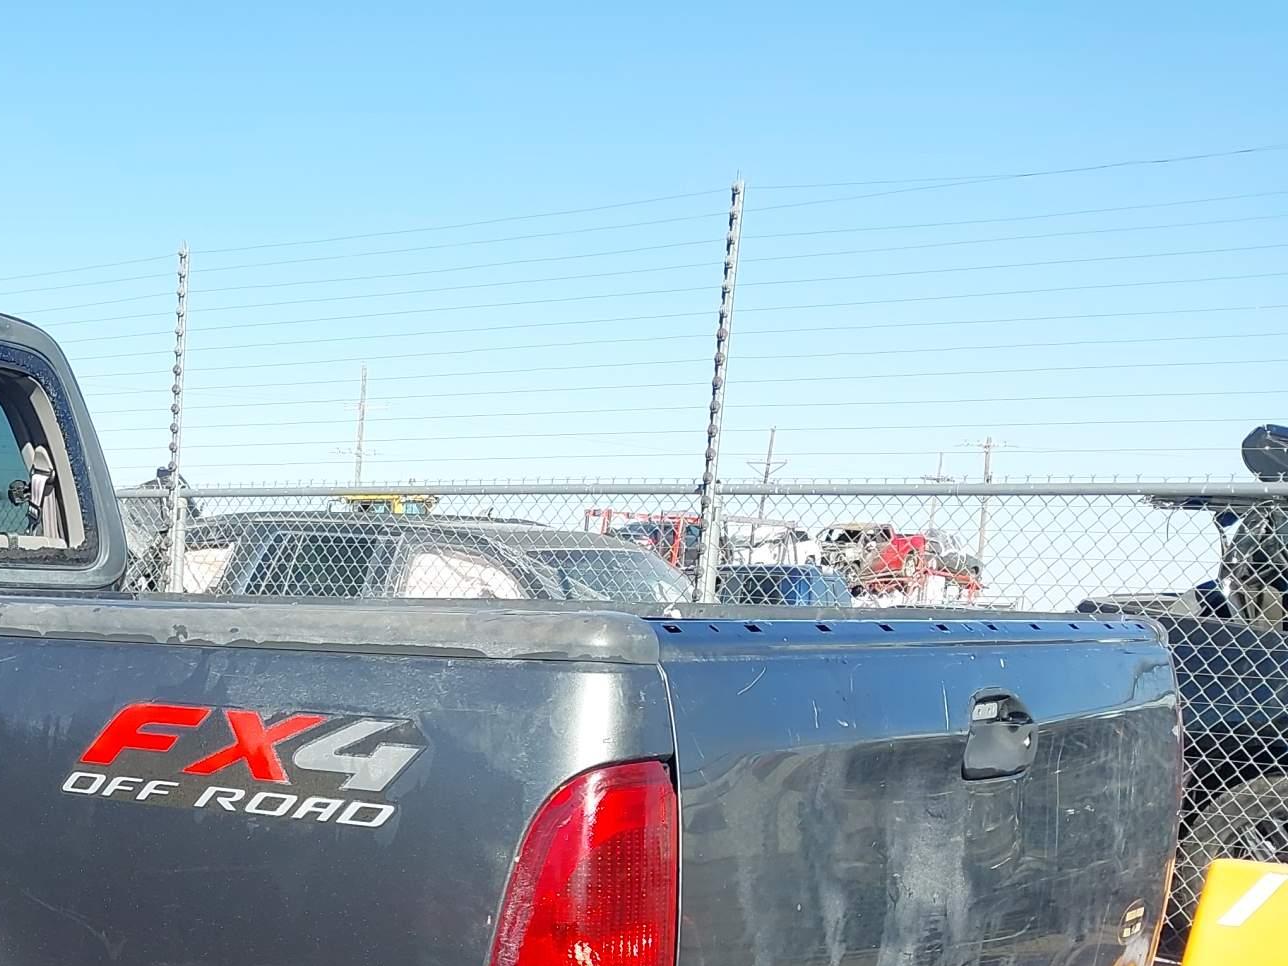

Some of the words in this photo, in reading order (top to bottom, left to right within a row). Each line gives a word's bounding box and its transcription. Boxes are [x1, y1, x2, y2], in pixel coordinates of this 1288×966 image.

[78, 702, 427, 792] FX4
[62, 770, 180, 801] OFF
[193, 786, 396, 828] ROAD
